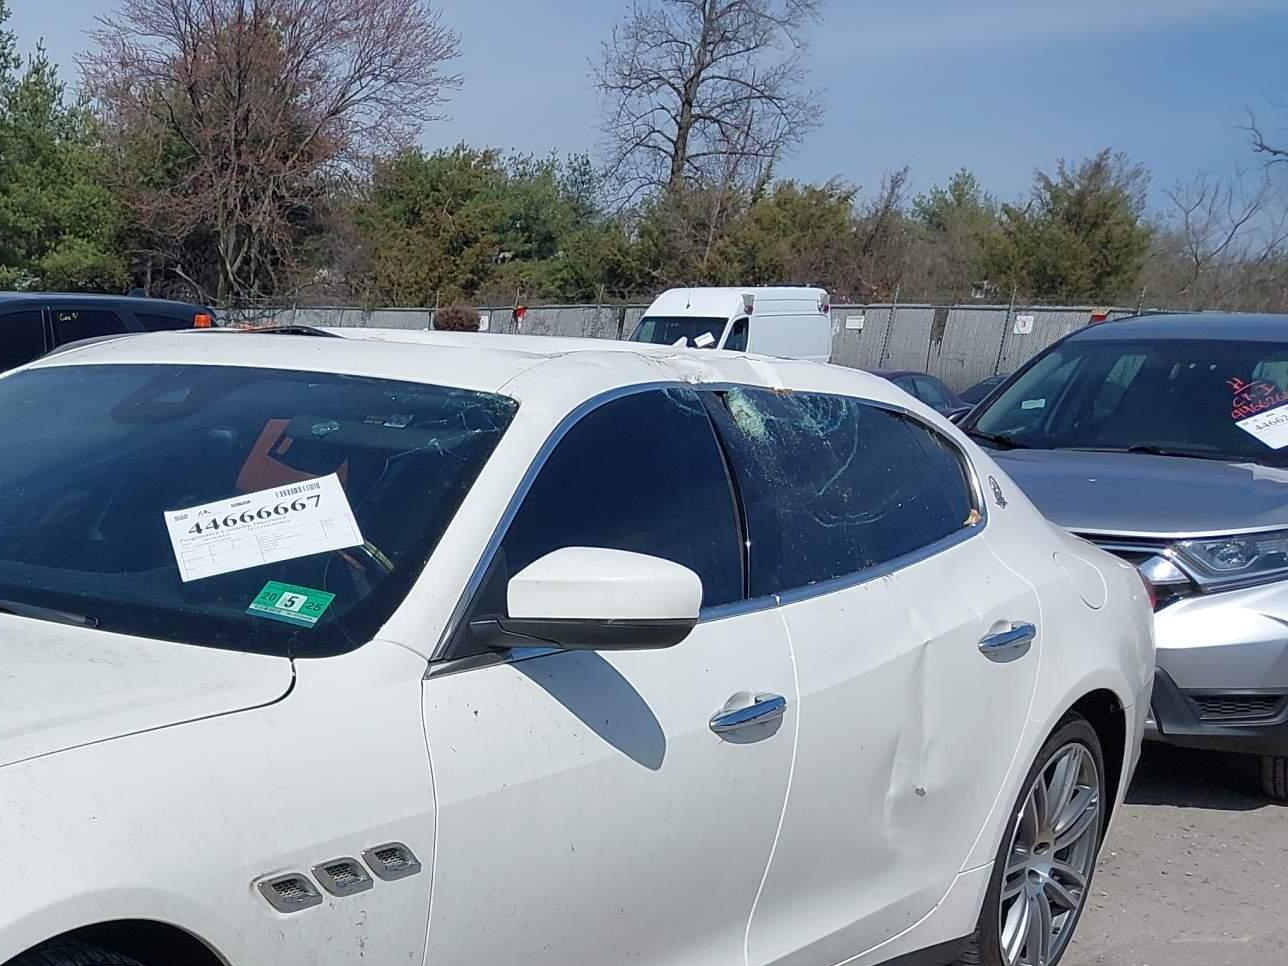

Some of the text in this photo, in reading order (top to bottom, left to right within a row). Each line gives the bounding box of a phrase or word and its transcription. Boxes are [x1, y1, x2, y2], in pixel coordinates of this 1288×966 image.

[188, 494, 321, 535] 44666667
[261, 591, 324, 612] 20 5 25
